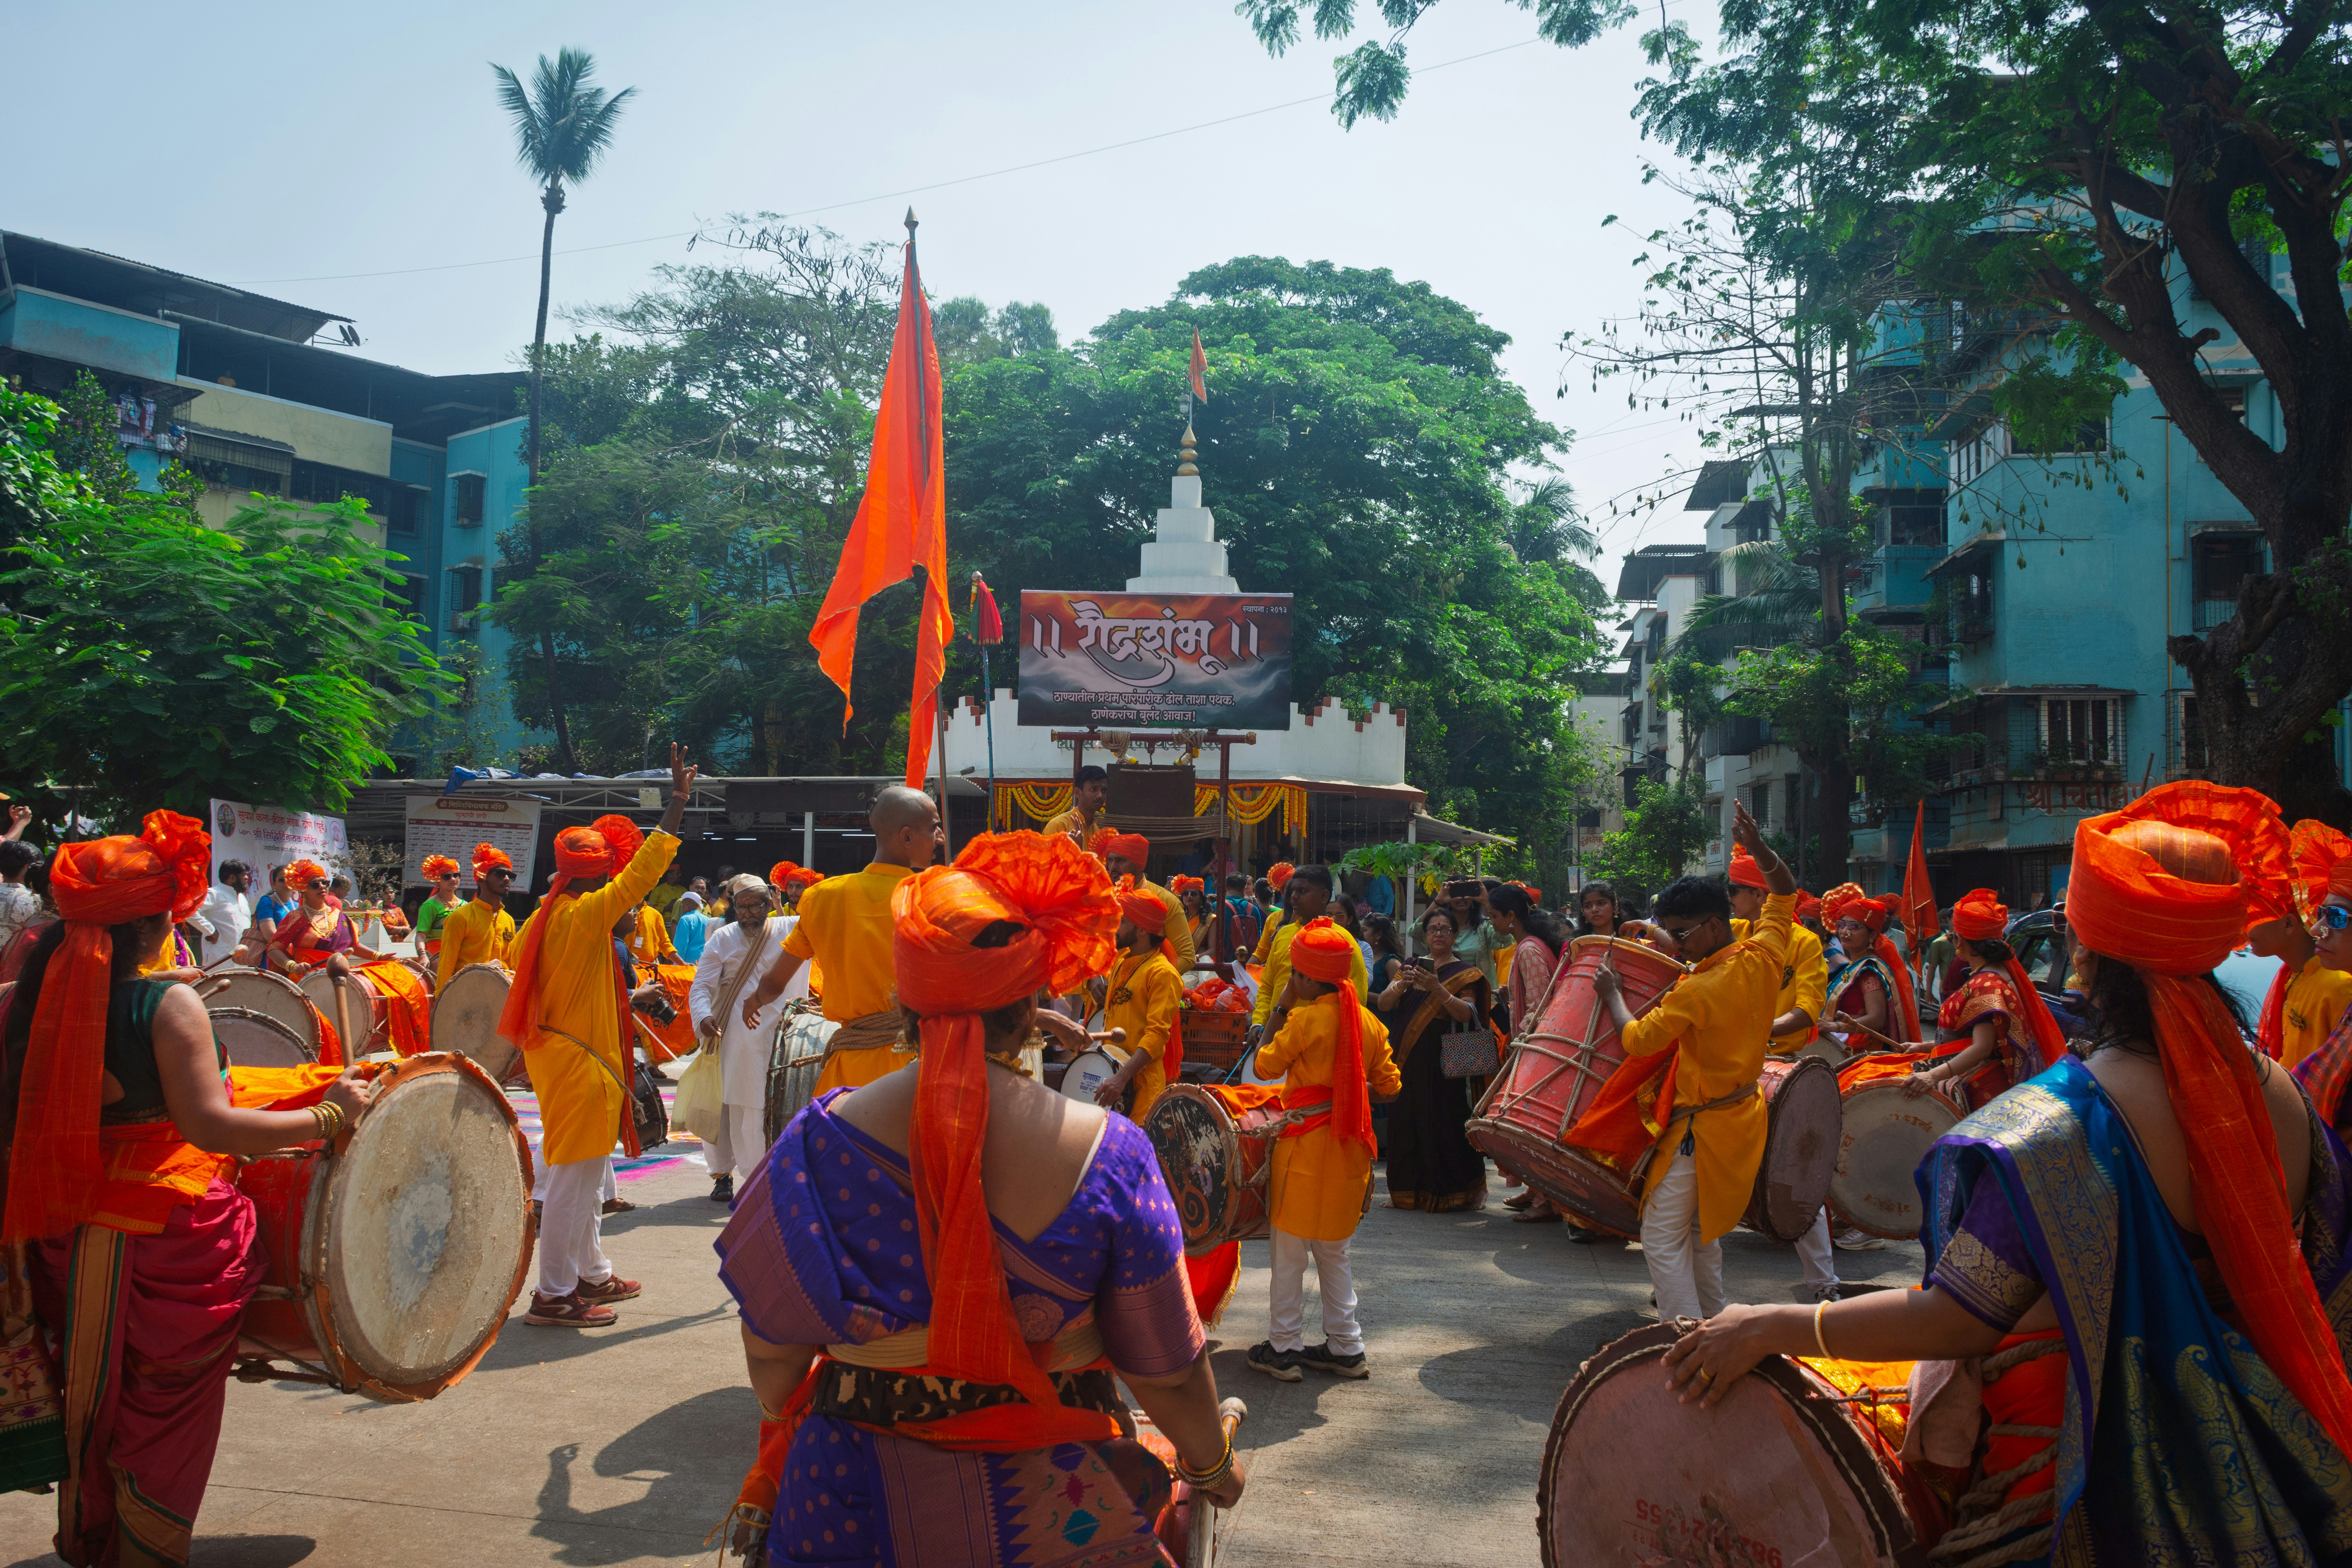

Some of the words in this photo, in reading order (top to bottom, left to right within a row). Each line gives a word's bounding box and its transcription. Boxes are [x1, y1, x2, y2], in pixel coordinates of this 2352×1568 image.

[1054, 690, 1095, 703] ठाण्यातील
[1098, 693, 1120, 704] प्रथम
[1122, 690, 1163, 704] पारंपारीक
[1165, 691, 1183, 705] ढोल
[1186, 694, 1206, 705] ताशा
[1209, 695, 1235, 706] पथक.
[1091, 706, 1137, 720] ठाणेकरांचा
[1140, 706, 1160, 724] बुलंद
[1163, 710, 1196, 722] आवाज!
[238, 811, 254, 823] सुयश
[302, 818, 312, 829] ठाणे
[303, 834, 318, 845] मंदिर
